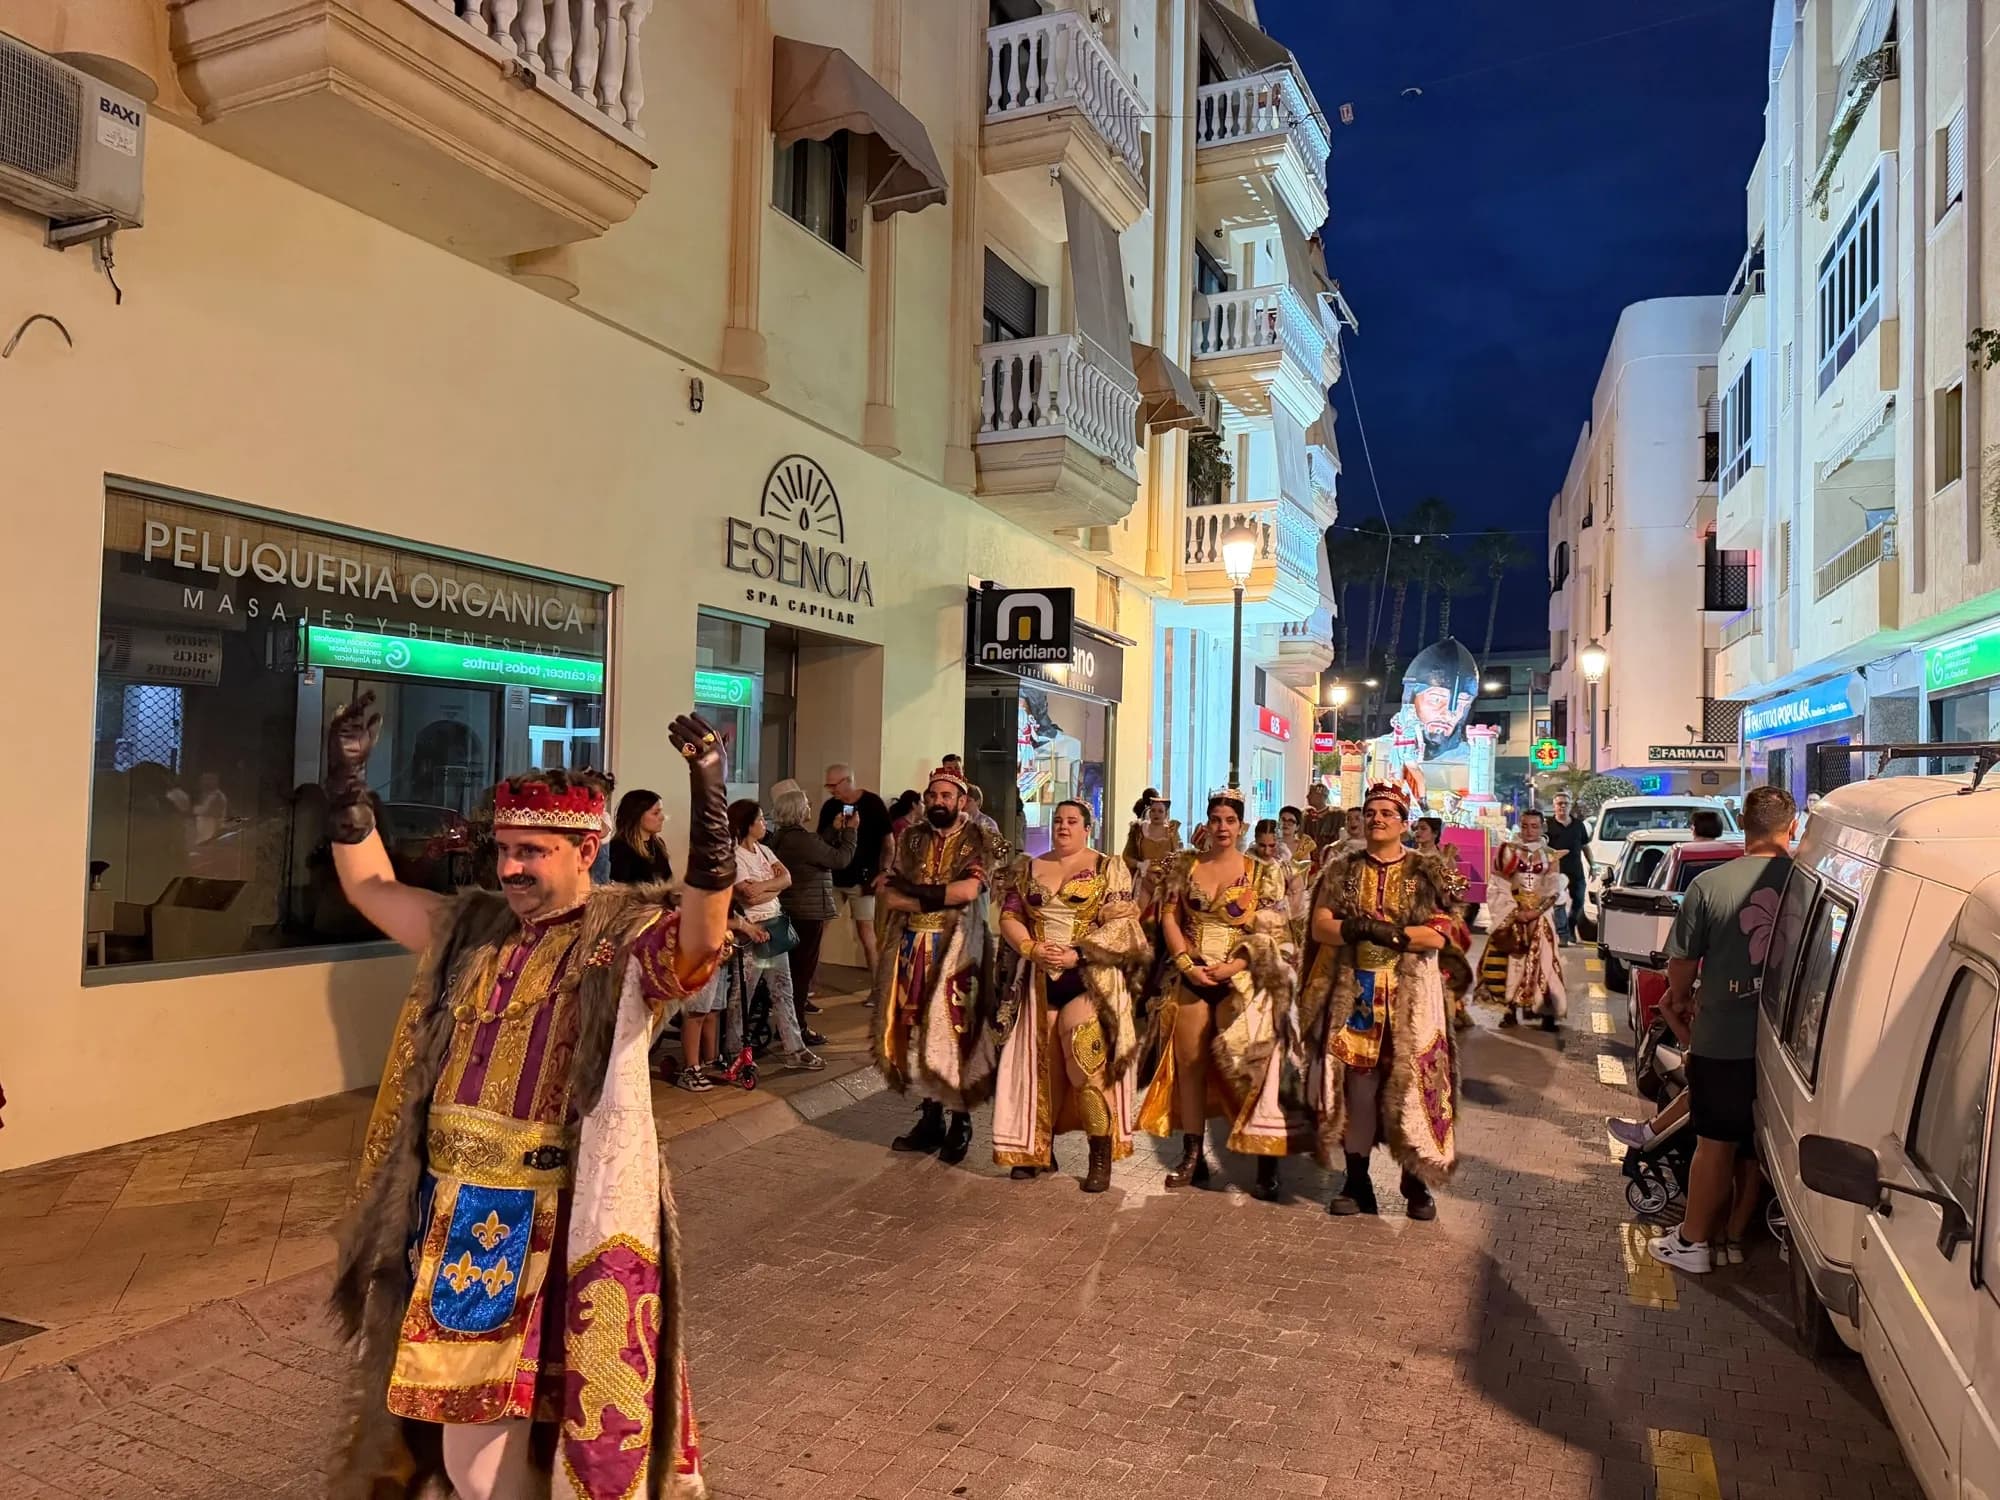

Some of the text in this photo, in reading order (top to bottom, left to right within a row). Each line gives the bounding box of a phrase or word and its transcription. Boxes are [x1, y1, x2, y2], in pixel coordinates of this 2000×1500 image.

[100, 96, 140, 127] BAXI
[144, 519, 584, 635] PELUQUERIA ORGANICA
[726, 516, 875, 607] ESENCIA
[183, 587, 561, 658] MASAJES Y BIENESTAR
[746, 588, 855, 625] SPA CAPILAR
[1751, 708, 1778, 733] PARTIDO
[1778, 698, 1812, 727] POPULAR
[1661, 748, 1725, 759] FARMACIA
